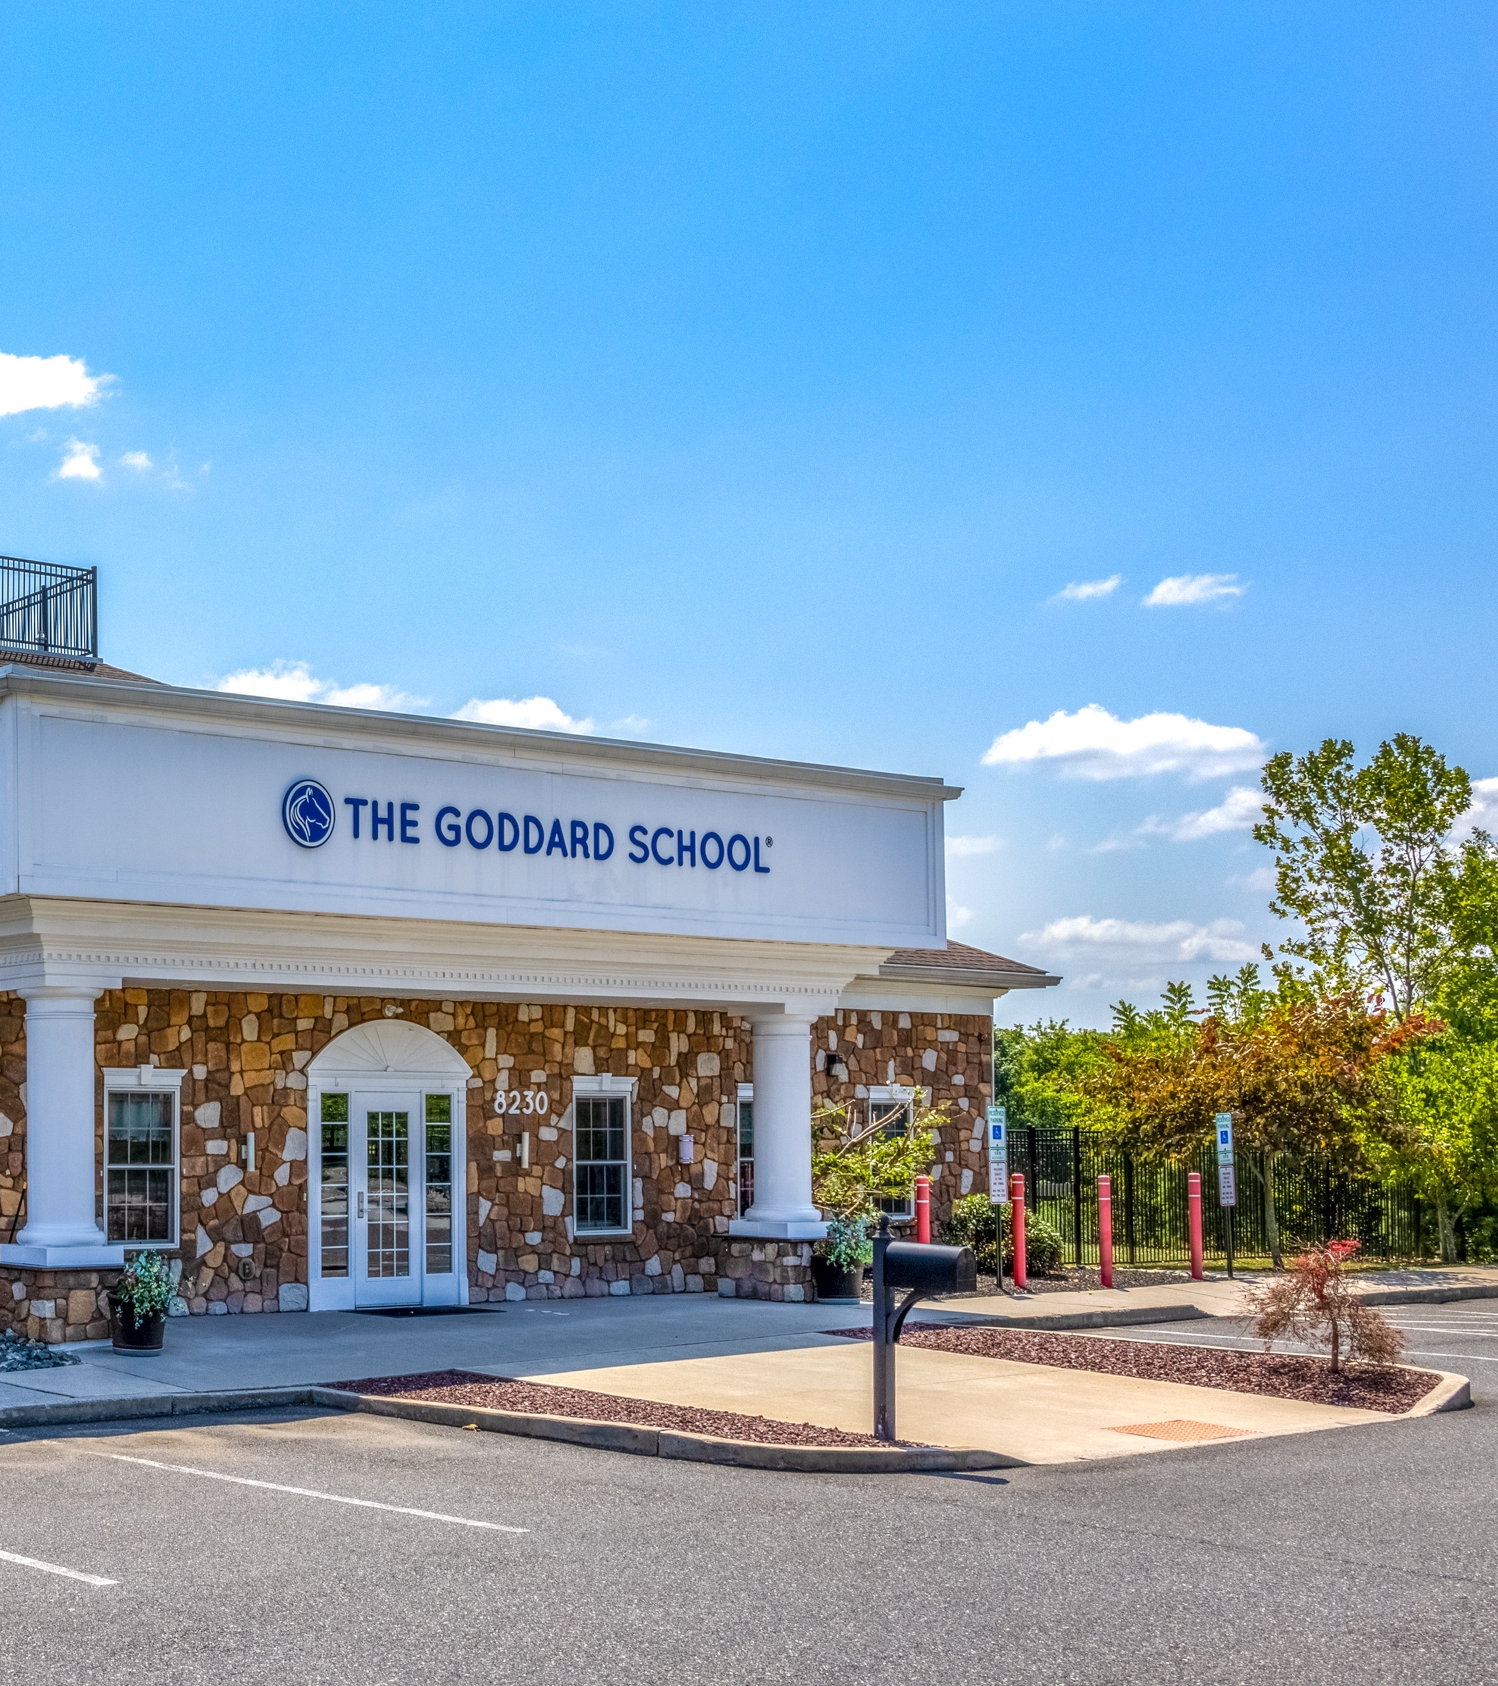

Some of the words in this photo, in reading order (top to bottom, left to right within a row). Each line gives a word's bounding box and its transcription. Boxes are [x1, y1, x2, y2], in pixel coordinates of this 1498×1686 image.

[344, 797, 420, 844] THE
[435, 806, 615, 861] GODDARD
[494, 1090, 548, 1115] 8230
